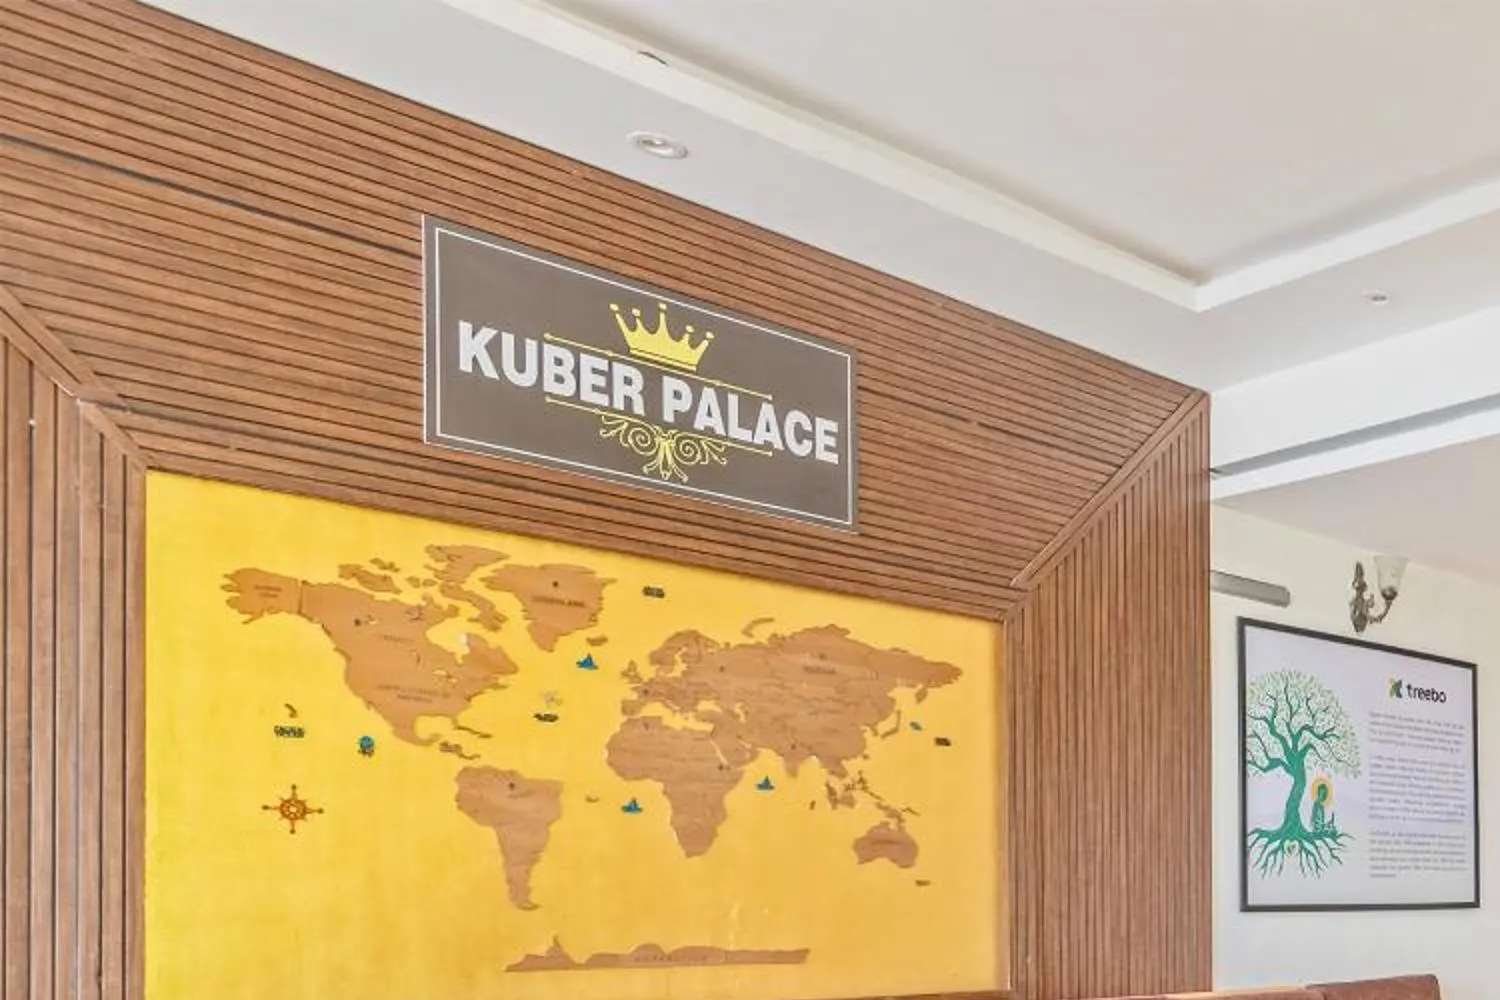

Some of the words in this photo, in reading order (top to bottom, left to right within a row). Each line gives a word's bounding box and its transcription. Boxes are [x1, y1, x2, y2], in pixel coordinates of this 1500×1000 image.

[458, 319, 646, 417] KUBER
[662, 375, 839, 465] PALACE
[1406, 683, 1447, 704] treebo
